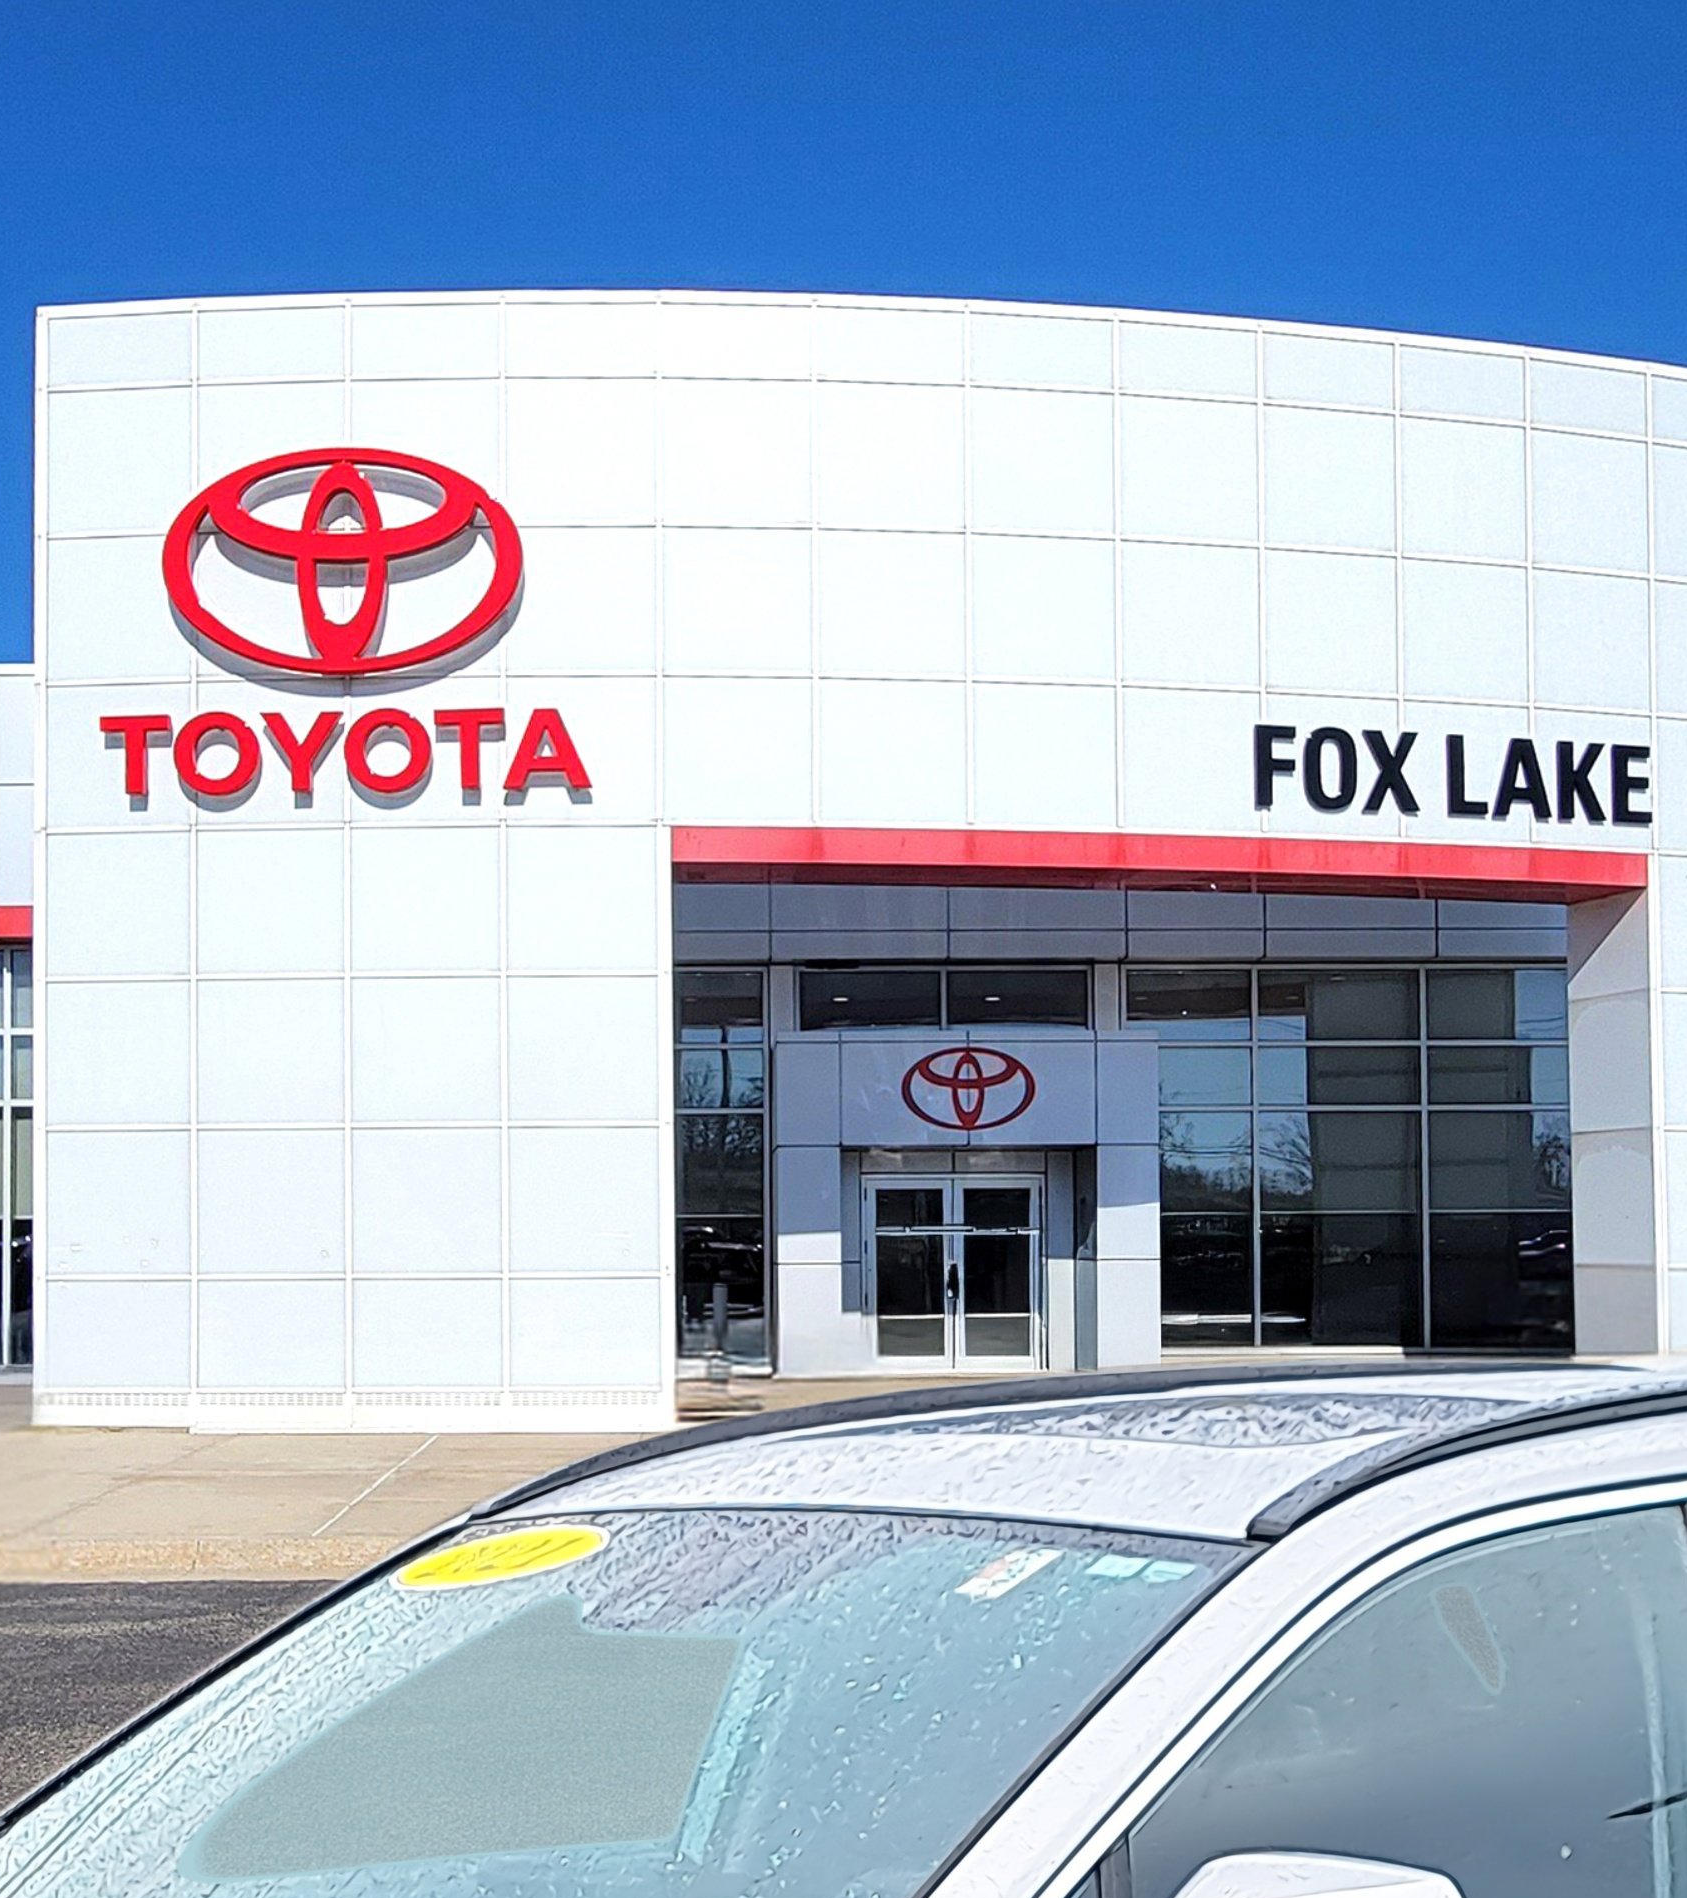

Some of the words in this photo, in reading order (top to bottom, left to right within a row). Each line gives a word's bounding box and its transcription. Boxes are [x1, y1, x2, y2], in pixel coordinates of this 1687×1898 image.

[99, 706, 593, 800] TOYOTA
[1253, 723, 1421, 816] FOX
[1445, 733, 1654, 825] LAKE
